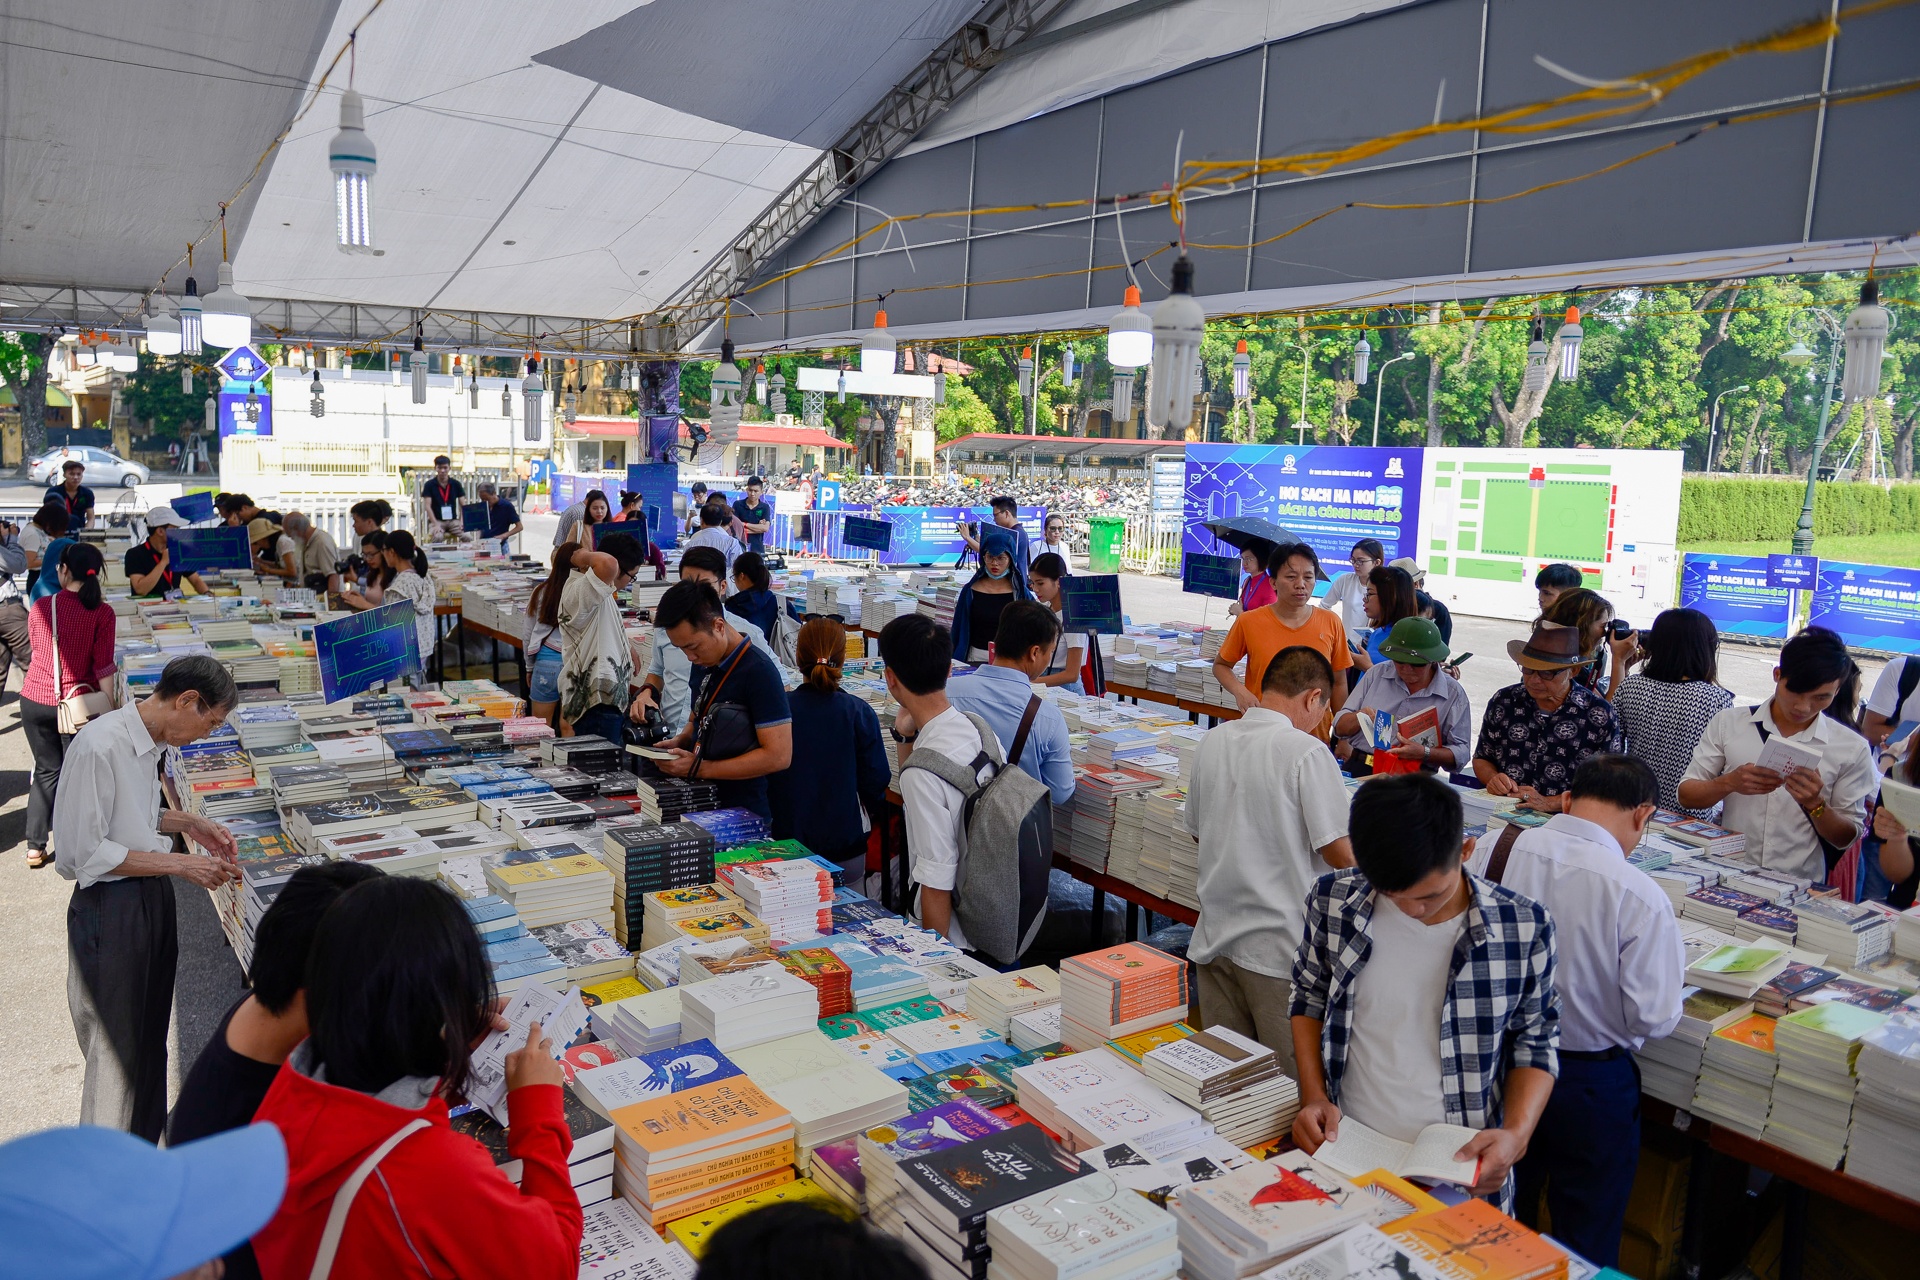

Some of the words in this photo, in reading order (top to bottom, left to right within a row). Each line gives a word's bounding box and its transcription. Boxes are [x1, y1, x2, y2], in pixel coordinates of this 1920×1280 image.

[821, 487, 835, 508] P
[1278, 503, 1307, 516] SÁCH
[1308, 506, 1317, 516] &
[1318, 505, 1350, 519] CÔNG
[1351, 508, 1386, 524] NGHỆ
[354, 639, 389, 660] -30%
[695, 905, 720, 914] TAROT
[1183, 1059, 1198, 1068] sao
[688, 1094, 707, 1106] CÓ
[703, 1108, 728, 1126] THỨC
[716, 1104, 738, 1118] BẢN
[717, 1084, 739, 1100] CHỦ
[730, 1099, 758, 1118] NGHĨA
[707, 1162, 718, 1172] CHỦ
[719, 1159, 733, 1170] NGHĨA
[742, 1153, 751, 1163] BẢN
[752, 1151, 758, 1159] CÓ
[763, 1148, 776, 1156] THỨC
[708, 1176, 718, 1184] CHỦ
[720, 1171, 734, 1183] NGHĨA
[742, 1166, 751, 1175] BẢN
[752, 1164, 759, 1172] CÓ
[764, 1160, 776, 1168] THỨC
[710, 1196, 720, 1205] CHỦ
[720, 1191, 735, 1203] NGHĨA
[743, 1185, 752, 1195] BẢN
[753, 1183, 759, 1191] CÓ
[764, 1178, 776, 1188] THỨC
[939, 1184, 971, 1207] CHRIS
[613, 1205, 632, 1222] STUART
[629, 1223, 652, 1244] DIAMOND
[1010, 1202, 1084, 1254] HARVARD
[666, 1250, 686, 1270] STUART
